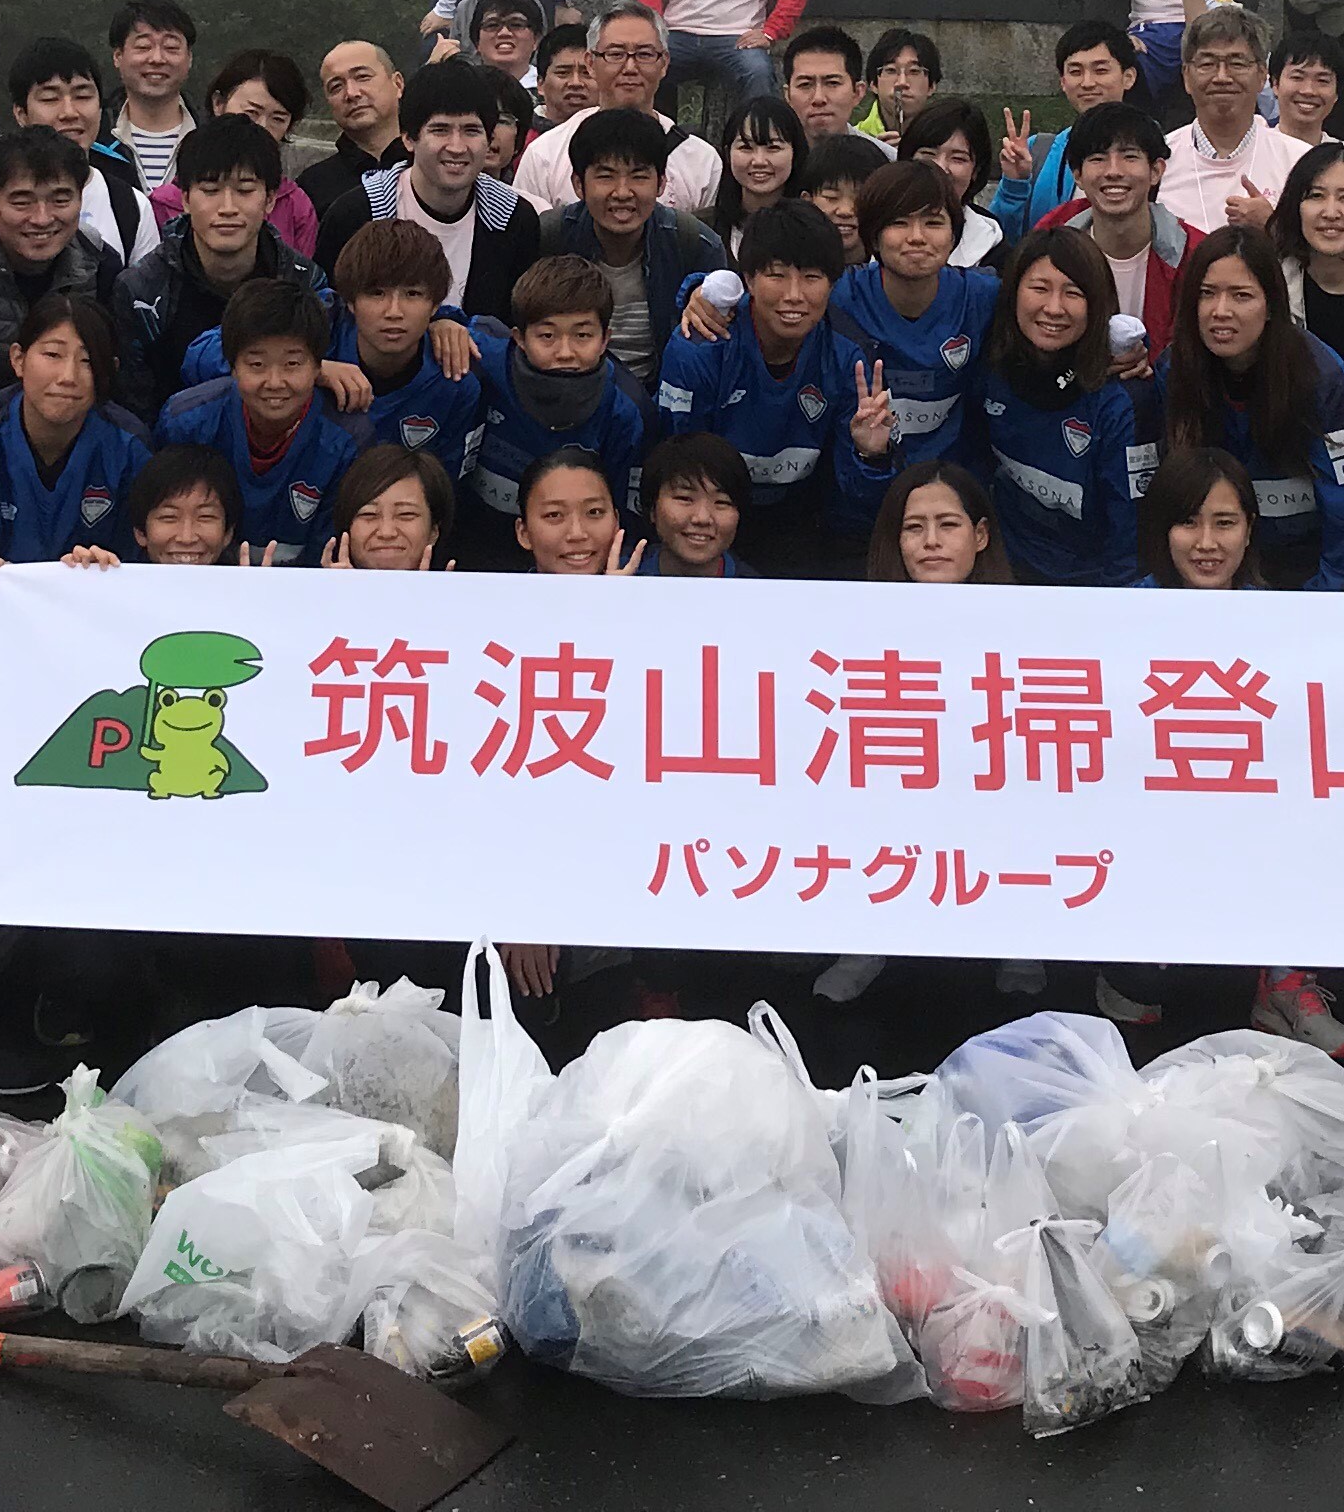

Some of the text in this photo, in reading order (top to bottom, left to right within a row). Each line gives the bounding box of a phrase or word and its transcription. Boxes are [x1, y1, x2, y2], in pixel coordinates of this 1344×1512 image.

[749, 460, 813, 476] ASONA
[89, 717, 132, 768] P
[646, 839, 1114, 910] パソナグループ
